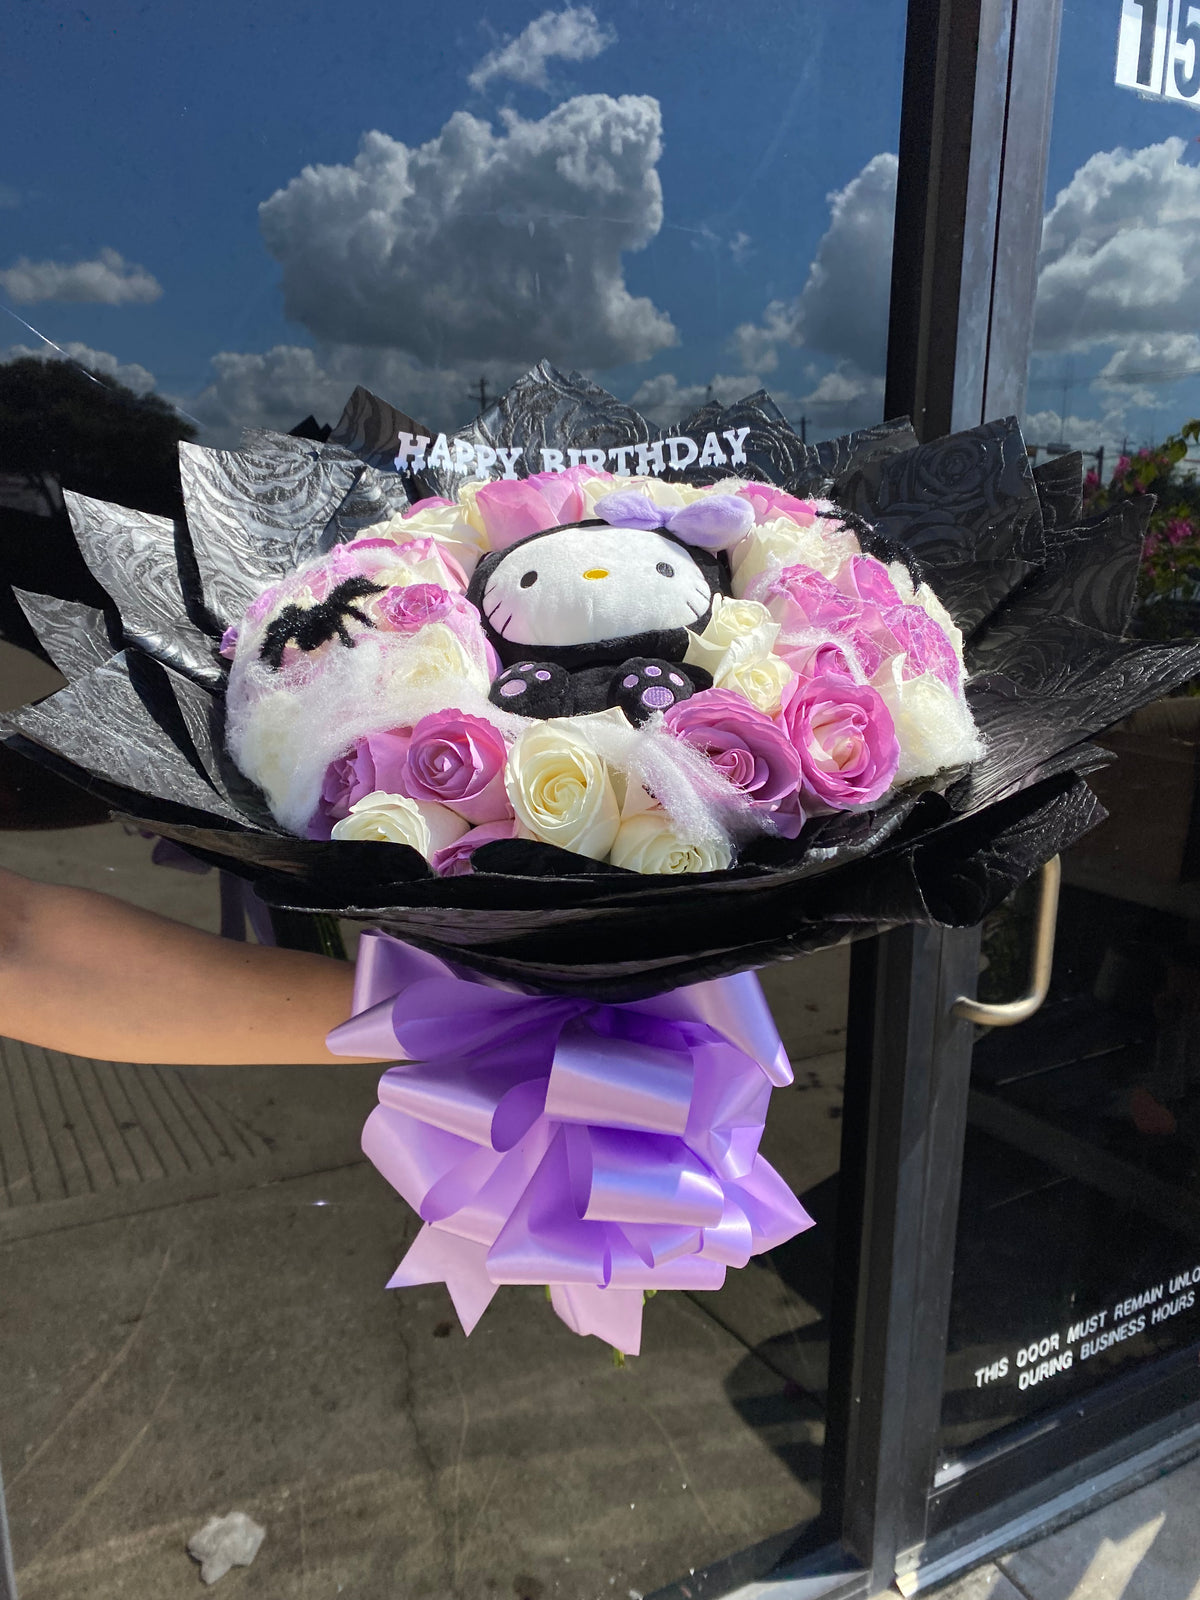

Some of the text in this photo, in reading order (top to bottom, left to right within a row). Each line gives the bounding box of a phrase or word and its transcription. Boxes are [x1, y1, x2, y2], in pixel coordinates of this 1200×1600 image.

[394, 427, 751, 481] HAPPY BIRTHDAY
[974, 1356, 1009, 1388] THIS
[1016, 1333, 1060, 1368] DOOR
[1066, 1310, 1108, 1344] MUST
[1113, 1284, 1164, 1321] REMAIN
[1018, 1291, 1196, 1391] DURING BUSINESS HOURS
